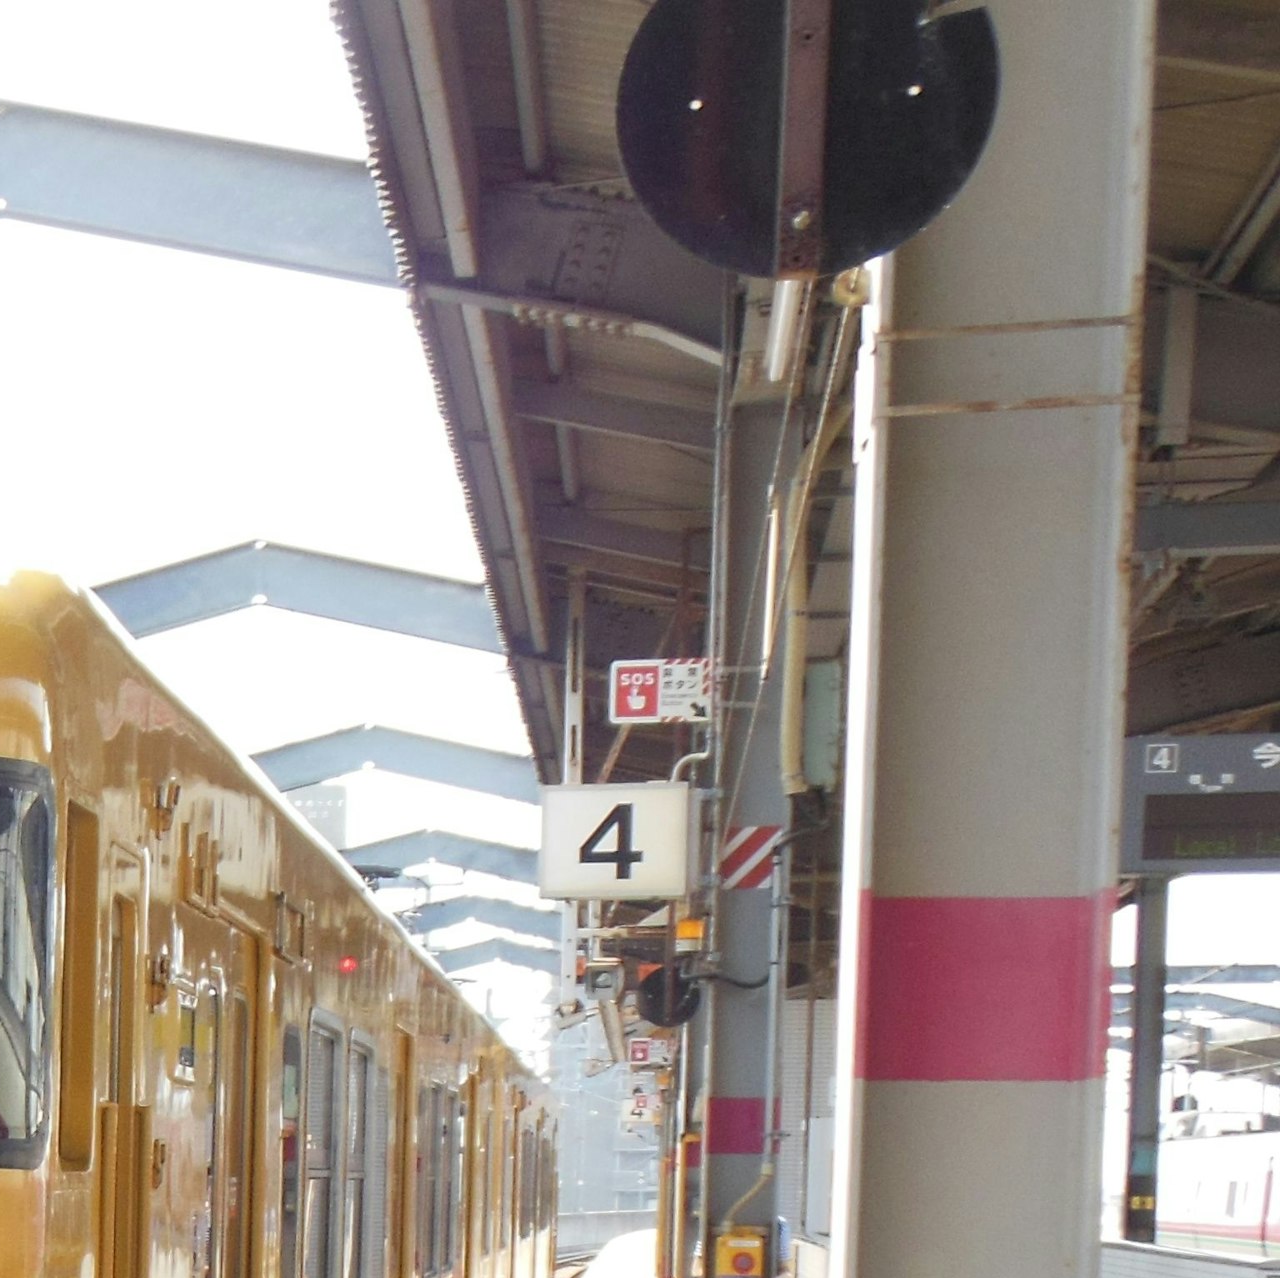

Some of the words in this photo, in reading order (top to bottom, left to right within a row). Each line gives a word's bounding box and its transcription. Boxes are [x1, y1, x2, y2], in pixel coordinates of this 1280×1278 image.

[620, 673, 655, 686] SOS
[1152, 747, 1172, 769] 4
[578, 801, 644, 880] 4
